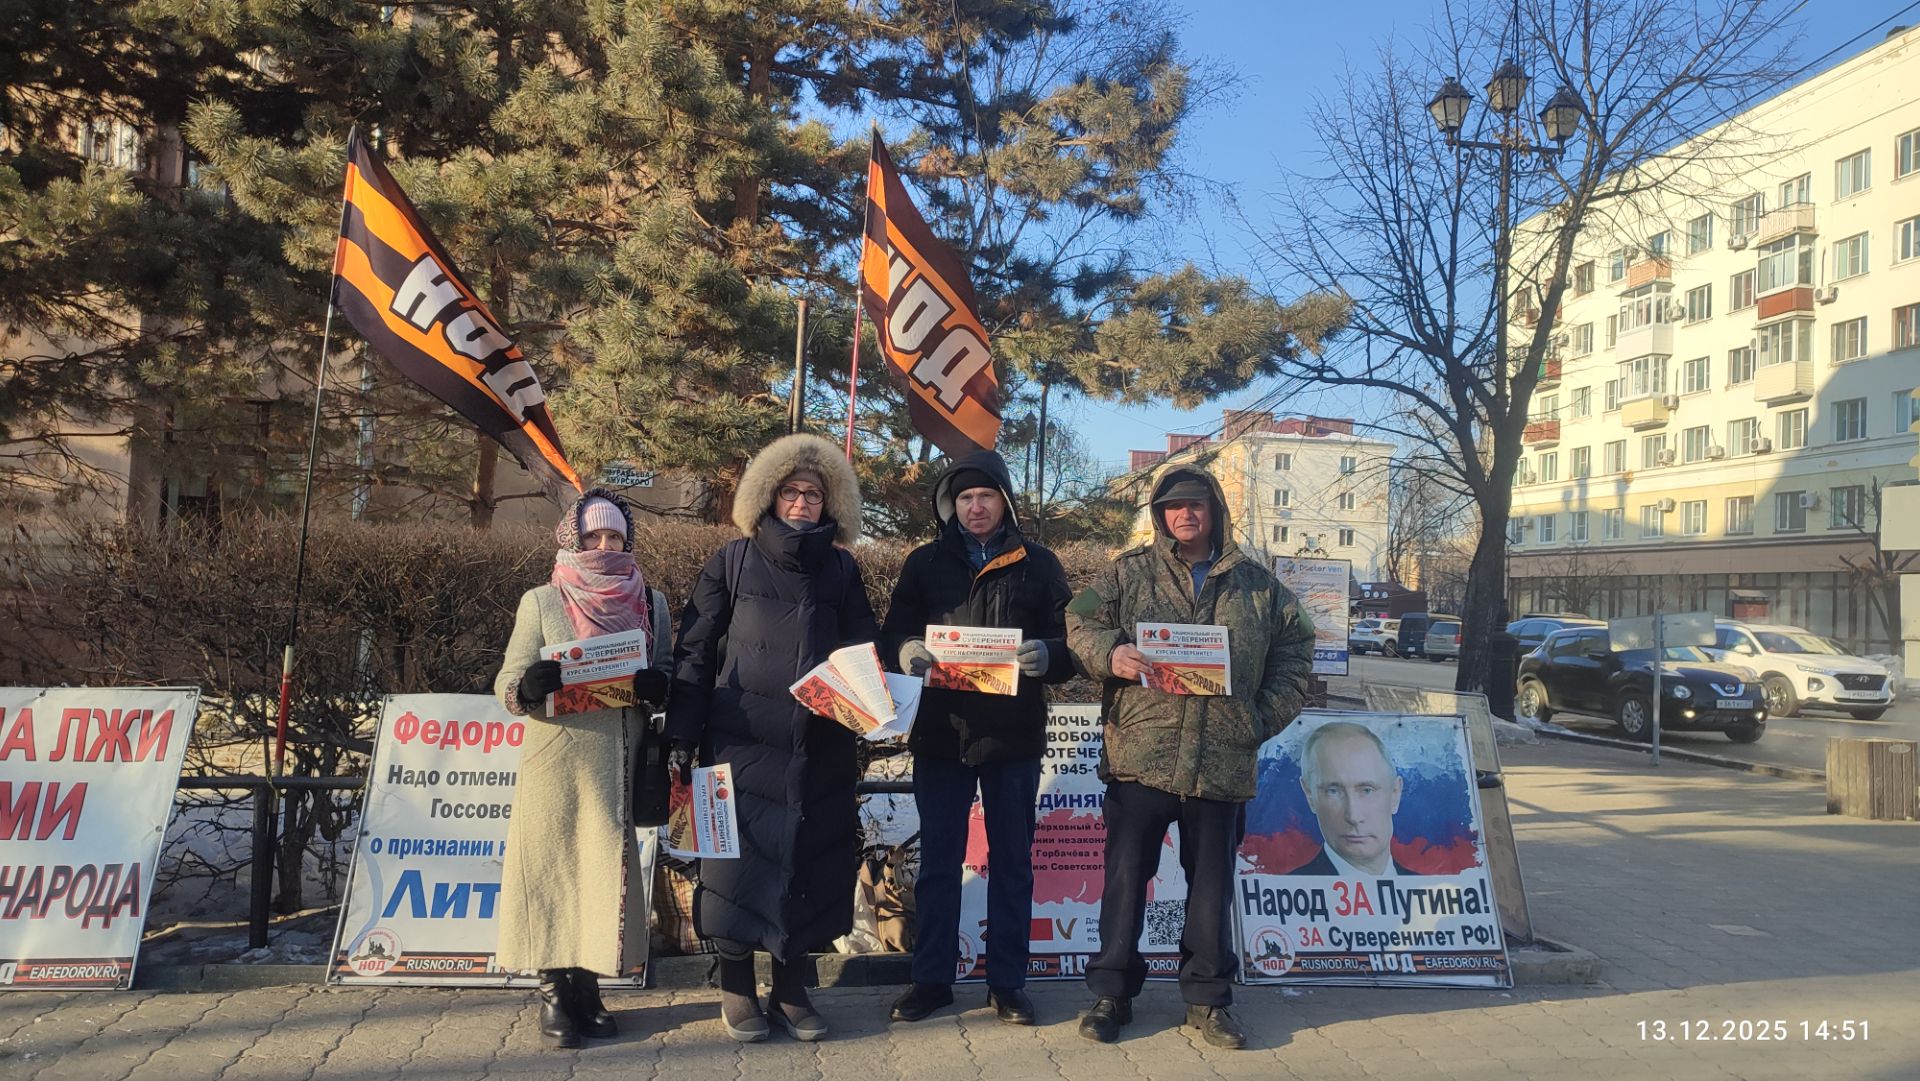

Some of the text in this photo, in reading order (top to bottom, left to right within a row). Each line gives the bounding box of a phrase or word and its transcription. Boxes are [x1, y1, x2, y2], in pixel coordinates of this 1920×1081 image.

[392, 254, 545, 423] НОД
[962, 637, 1016, 645] СУВЕРЕНИТЕТ
[1172, 635, 1223, 643] СУВЕРЕНИТЕТ
[585, 645, 641, 659] СУВЕРЕНИТЕТ
[567, 668, 581, 677] КУРС
[591, 661, 629, 673] СУВЕРЕНИТЕТ
[0, 708, 175, 762] А ЛЖИ
[387, 764, 440, 788] Надо
[430, 798, 512, 819] Госсове
[1035, 790, 1106, 811] ДИНЯ
[715, 801, 727, 853] СУВЕРЕНИТЕТ
[1036, 823, 1091, 832] Верховный
[370, 838, 383, 855] о
[387, 838, 494, 860] признании
[0, 862, 140, 929] НАРОДА
[381, 870, 502, 919] Лит
[1241, 878, 1491, 924] Народ ЗА Путина!
[1298, 927, 1324, 947] ЗА
[1328, 926, 1455, 950] Суверенитет
[1461, 925, 1496, 946] РФ!
[358, 960, 386, 972] НОД
[406, 958, 473, 972] RUSNOD.RU
[1027, 960, 1047, 972] .RU
[1263, 960, 1286, 971] НОД
[1301, 957, 1359, 970] RUSNOD.RU
[1369, 953, 1417, 973] НОД
[1425, 955, 1497, 970] EAFEDOROV.RU
[29, 965, 119, 980] EAFEDOROV.RU
